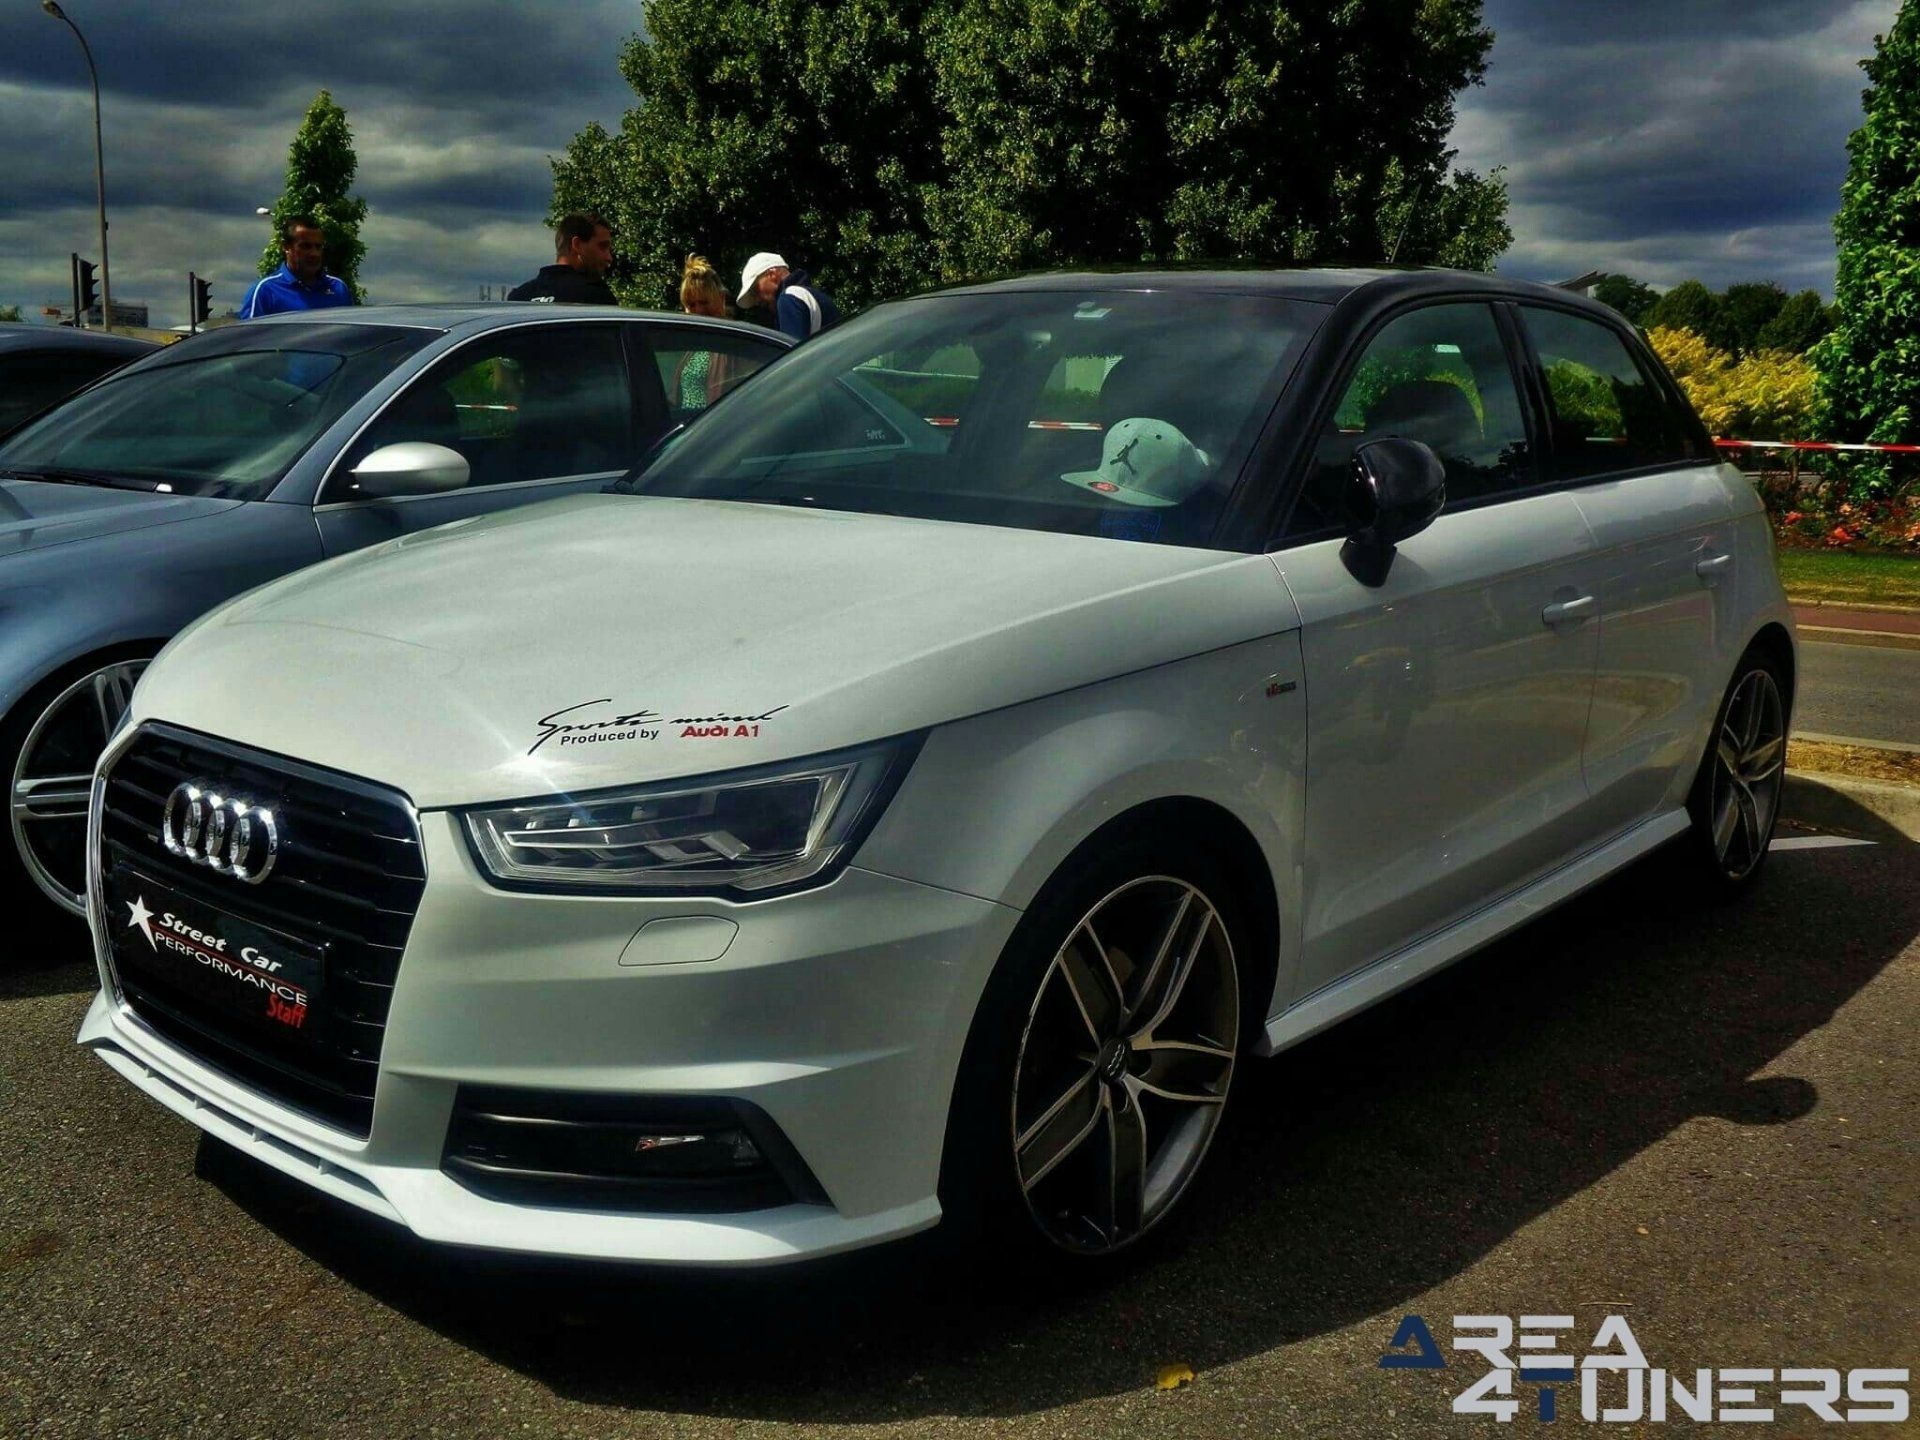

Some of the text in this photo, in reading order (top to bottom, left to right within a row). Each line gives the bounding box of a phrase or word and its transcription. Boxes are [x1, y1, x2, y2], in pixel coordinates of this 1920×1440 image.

[560, 728, 660, 746] Produced by
[733, 724, 760, 738] A1
[159, 912, 282, 973] Street Car
[155, 931, 308, 1007] PERFORMANCE
[266, 994, 309, 1028] Staff
